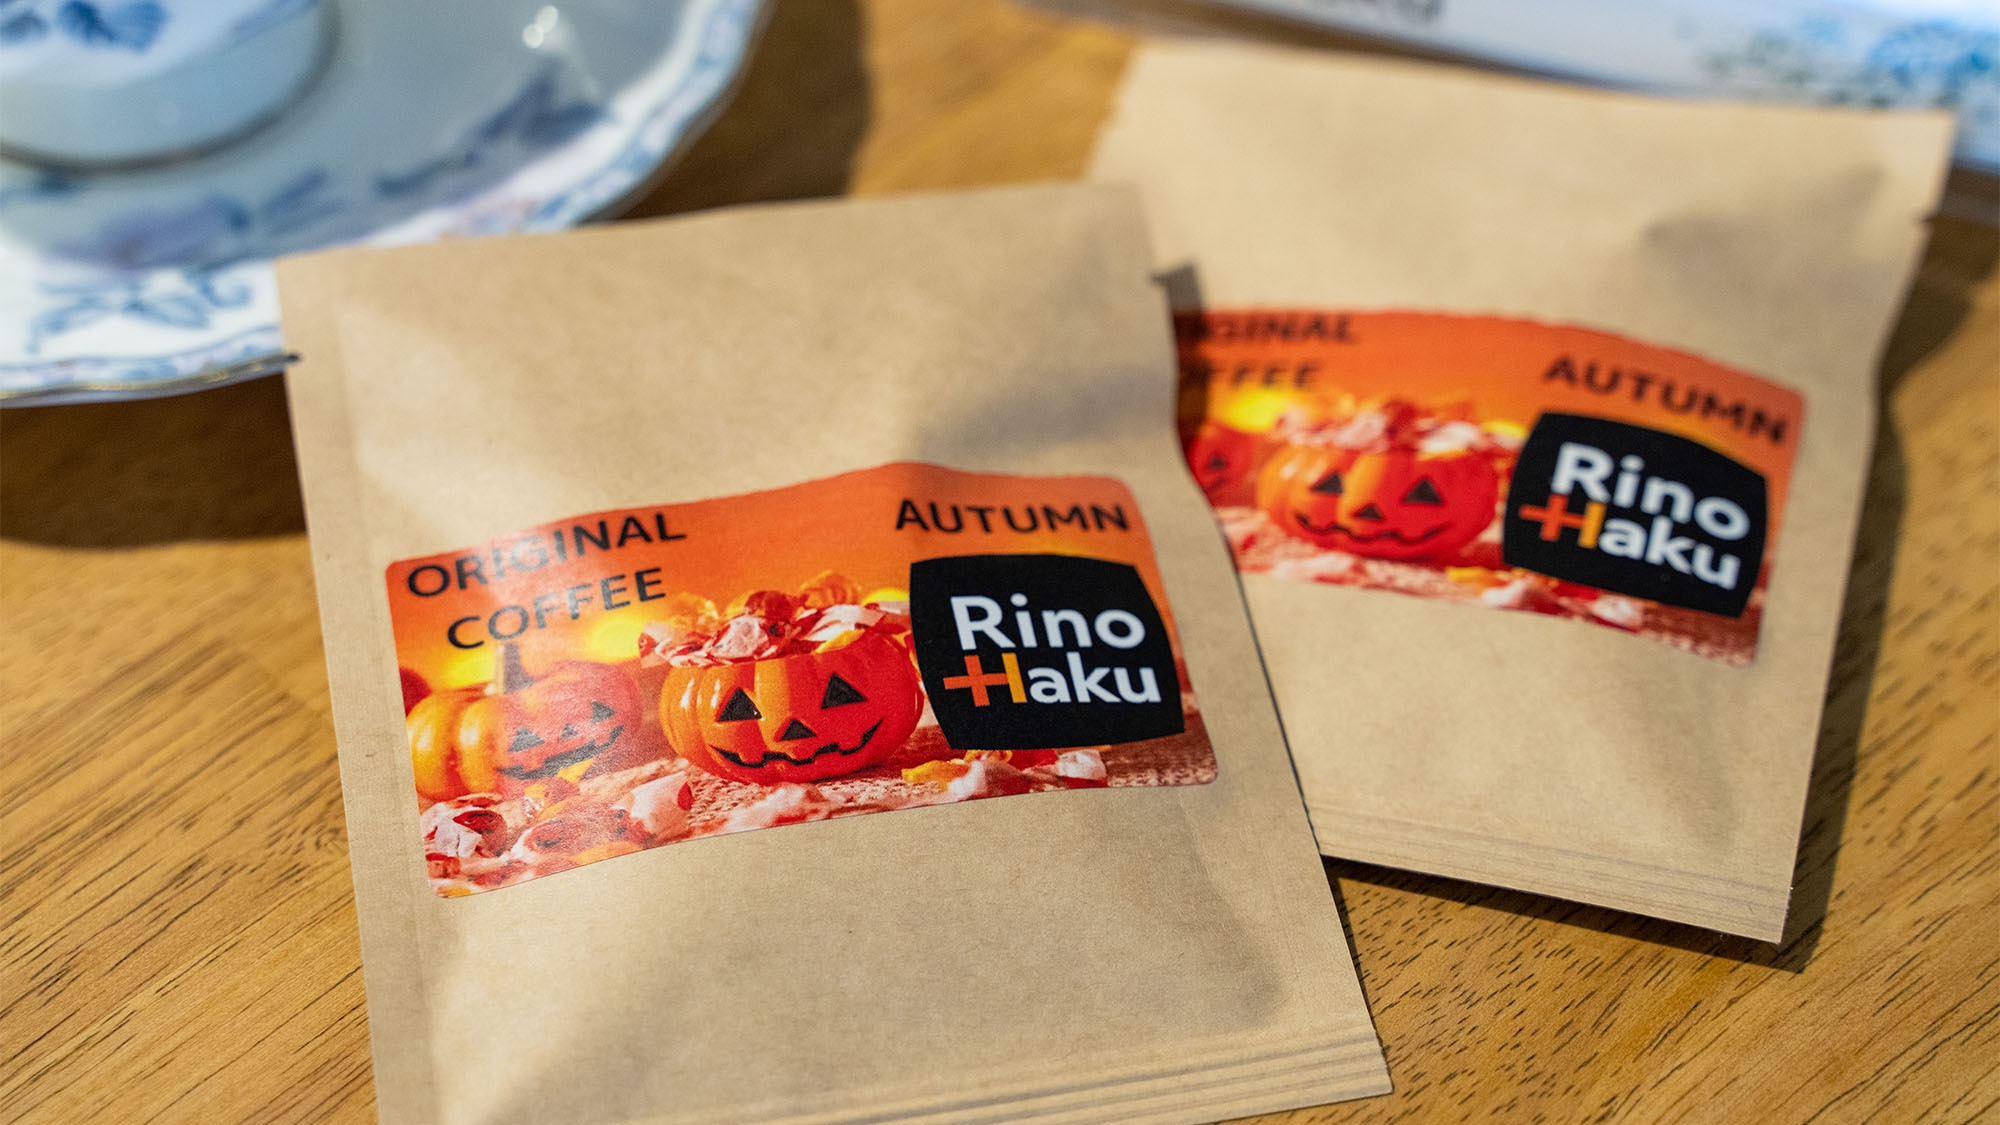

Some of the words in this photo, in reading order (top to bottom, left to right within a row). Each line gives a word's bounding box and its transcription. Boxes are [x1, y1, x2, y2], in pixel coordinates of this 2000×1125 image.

[1544, 355, 1787, 446] AUTUMN
[896, 498, 1129, 534] AUTUMN
[1551, 441, 1750, 540] Rino
[407, 512, 687, 597] ORIGINAL
[447, 567, 666, 650] COFFEE
[950, 593, 1146, 650] Rino
